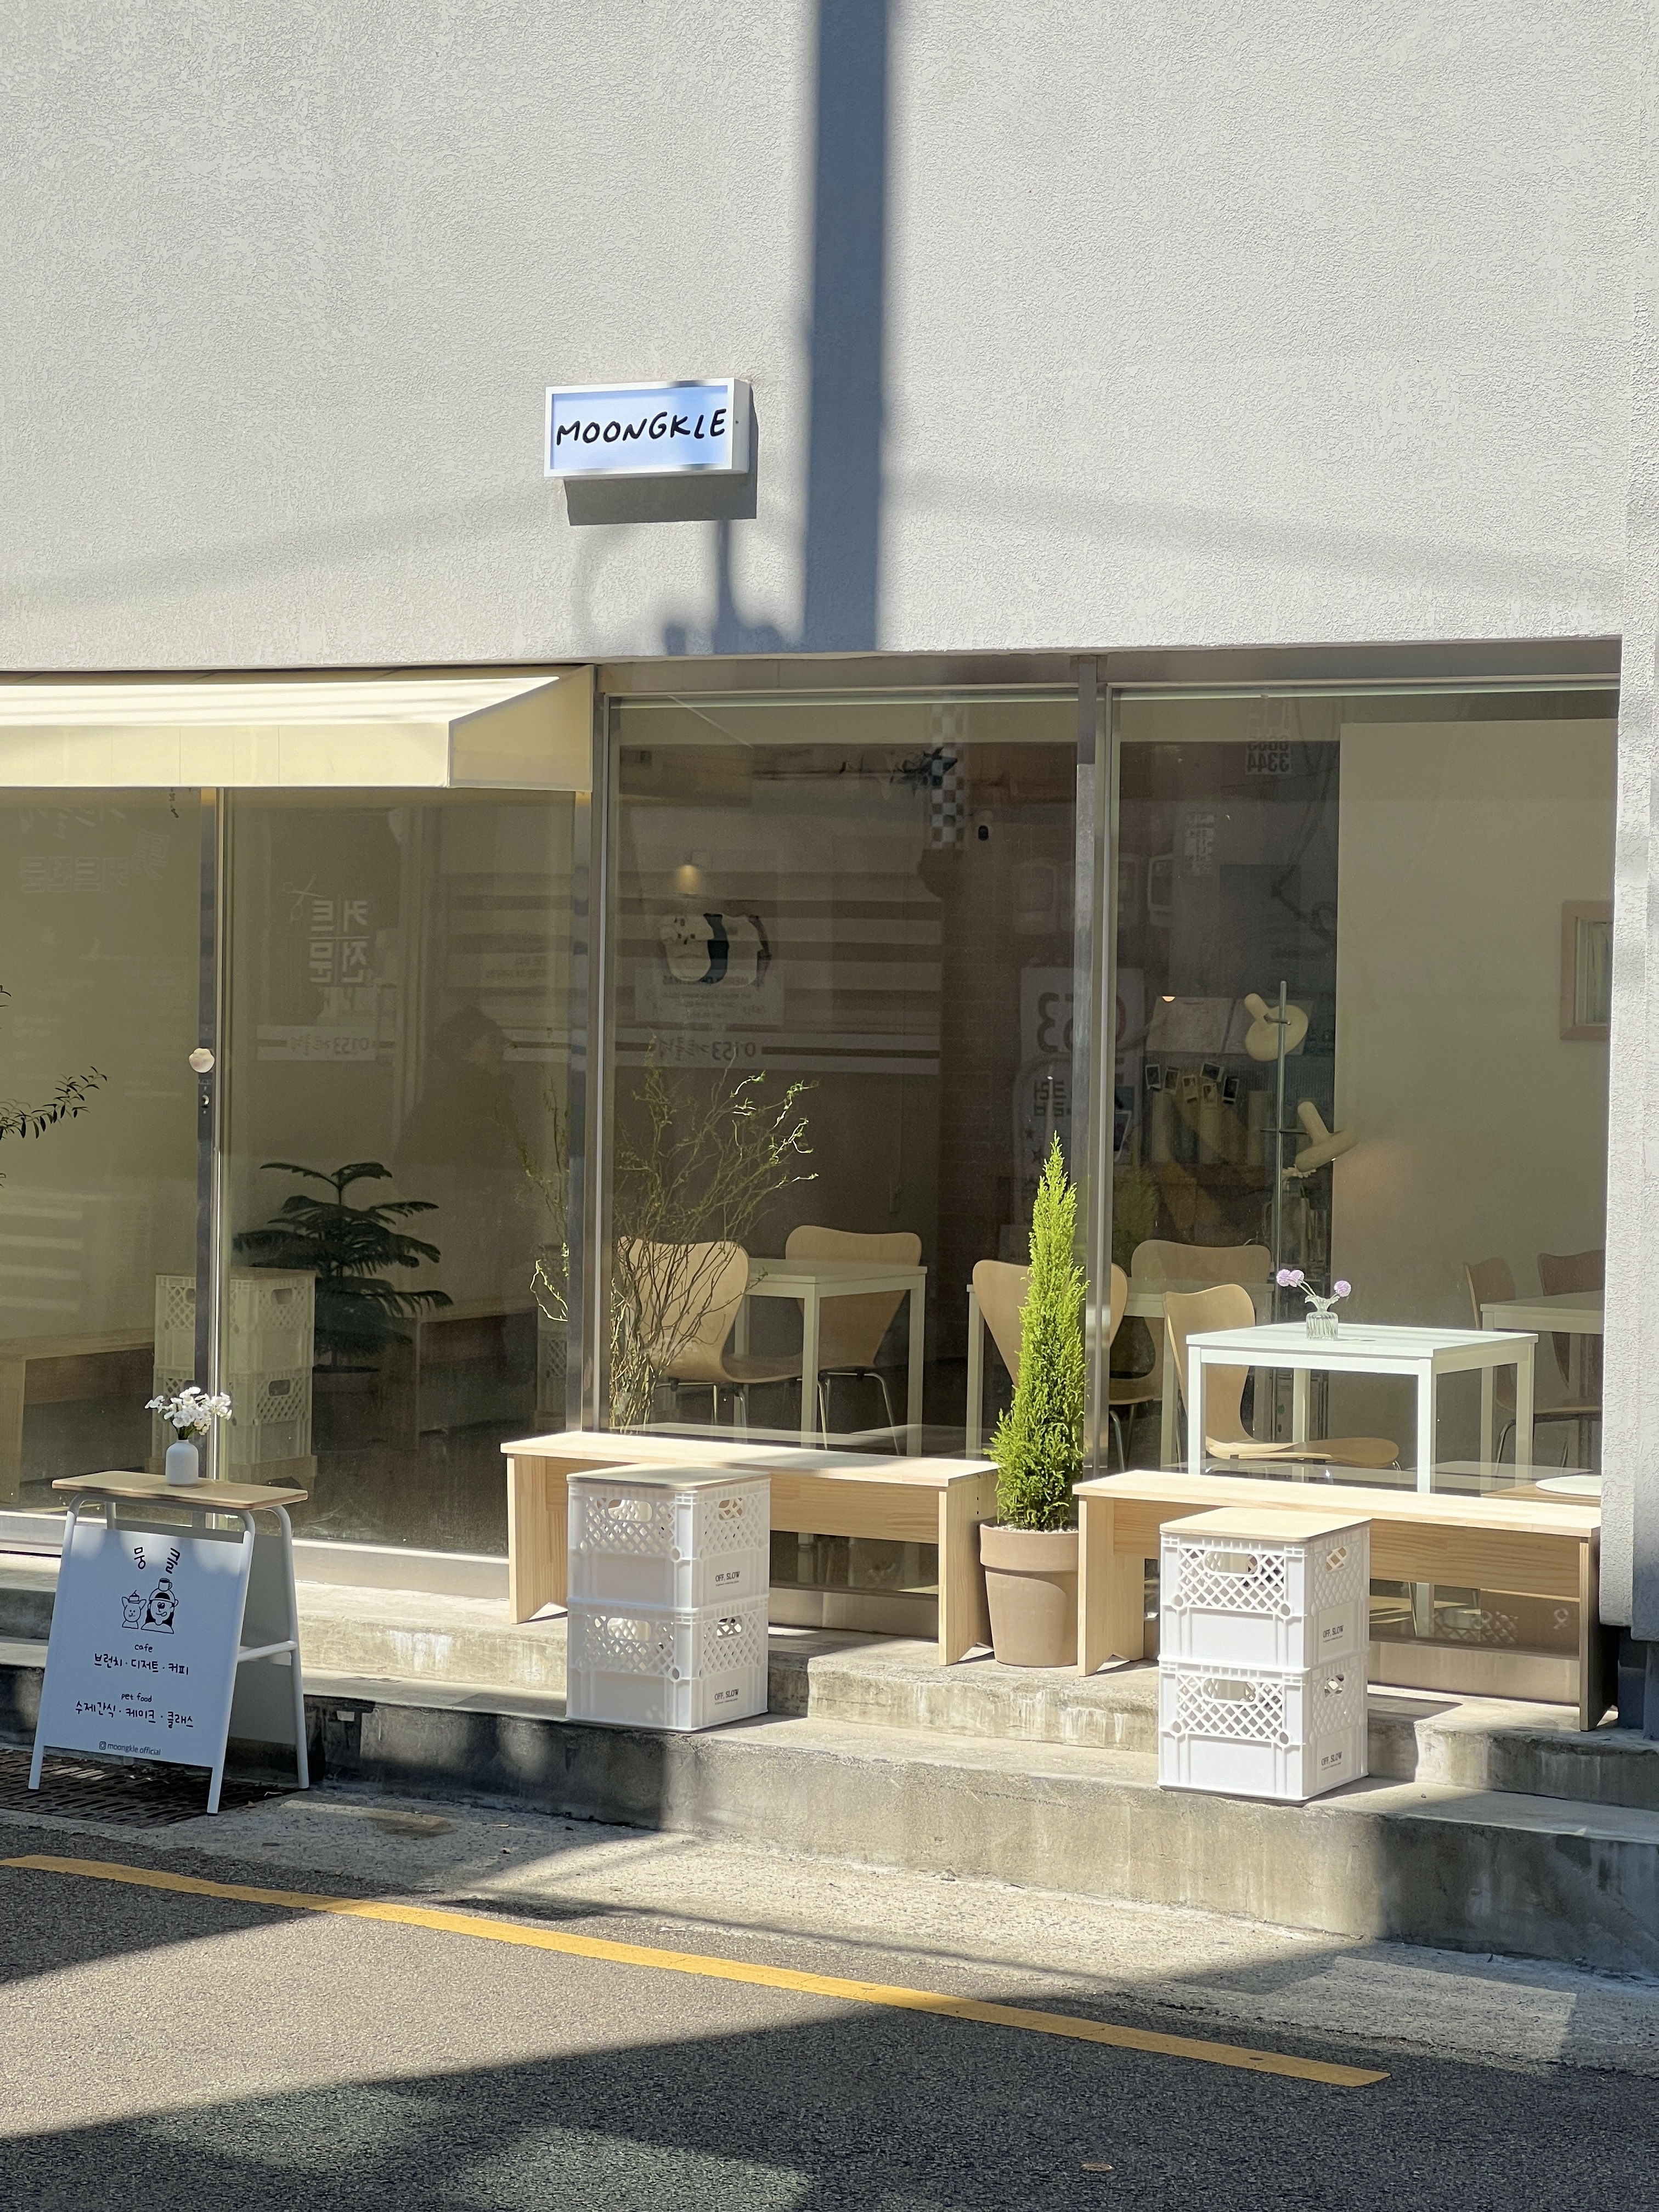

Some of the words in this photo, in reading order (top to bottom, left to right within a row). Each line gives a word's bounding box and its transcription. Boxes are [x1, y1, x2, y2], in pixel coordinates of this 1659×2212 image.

[556, 408, 727, 446] MOONGKLE
[726, 1571, 740, 1580] SLOW
[134, 1643, 153, 1652] cafe
[94, 1653, 122, 1668] 브런치
[131, 1659, 159, 1673] 디저트
[168, 1663, 189, 1675] 커피
[137, 1692, 152, 1702] food
[126, 1708, 156, 1724] 케이크
[167, 1711, 194, 1729] 클래스
